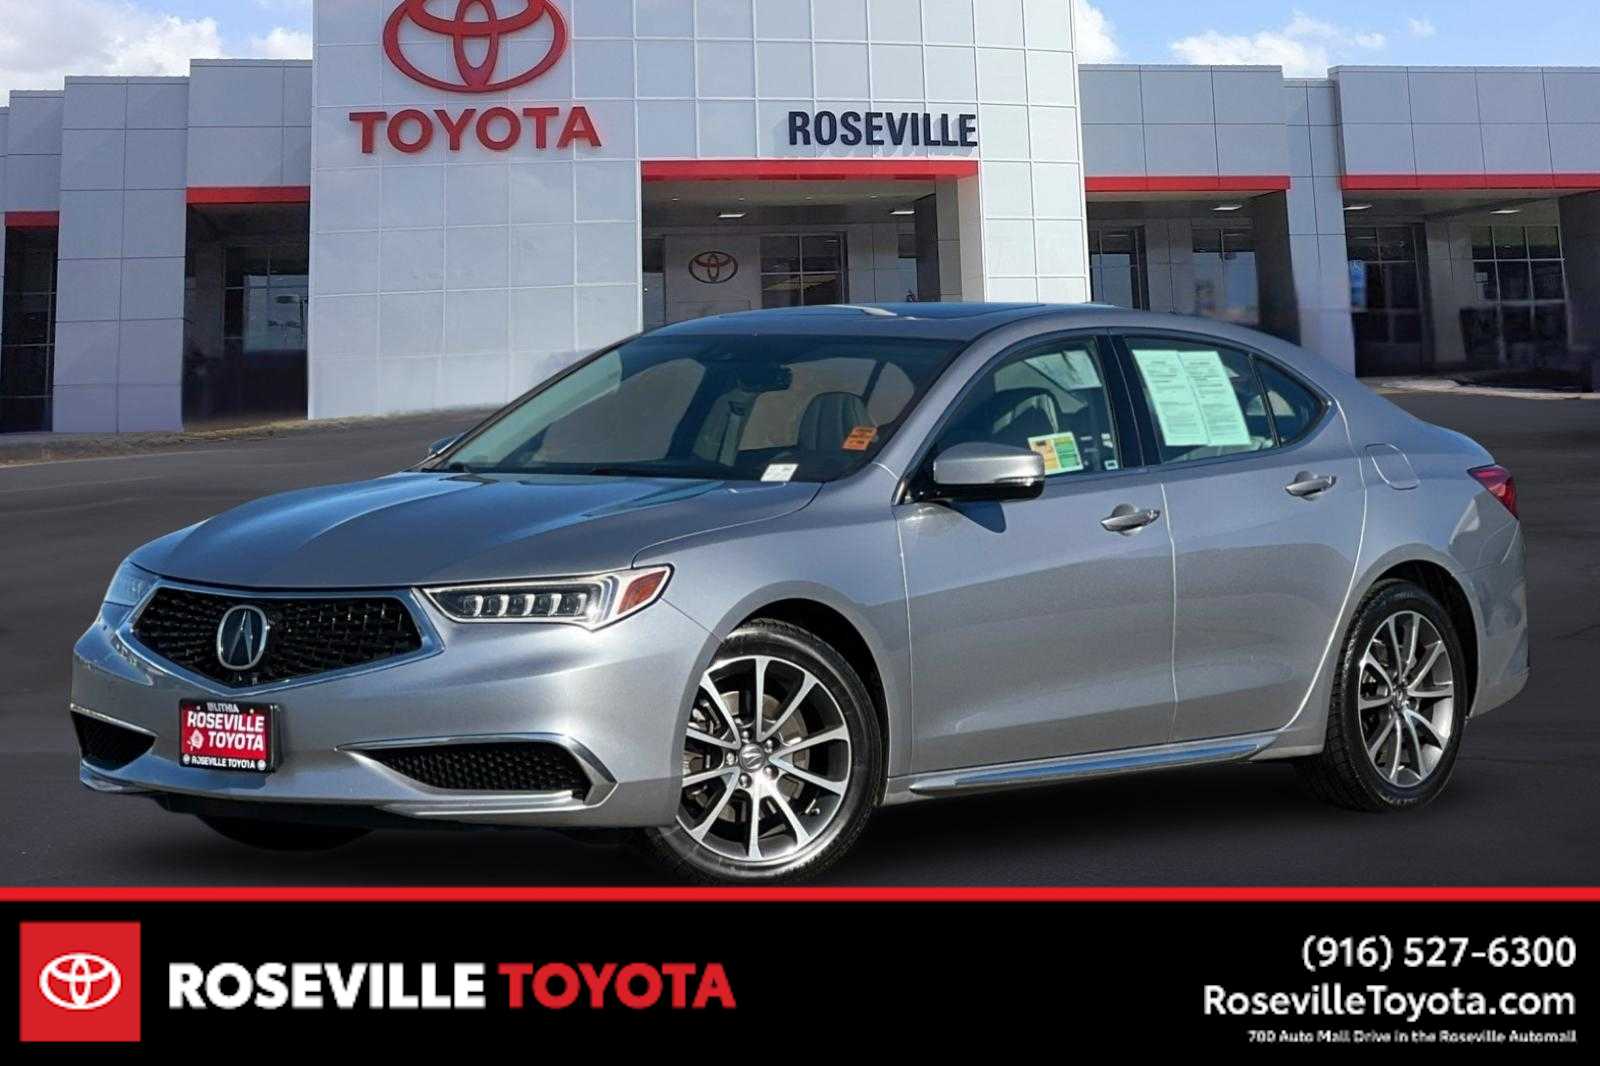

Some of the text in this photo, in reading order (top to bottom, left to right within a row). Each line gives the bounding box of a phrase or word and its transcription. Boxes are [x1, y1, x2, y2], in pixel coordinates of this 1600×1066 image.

[350, 107, 602, 153] TOYOTA
[789, 111, 977, 147] ROSEVILLE
[187, 711, 264, 732] ROSEVILLE
[208, 731, 264, 751] TOYOTA
[191, 755, 256, 769] ROSEVILLE TOYOTA
